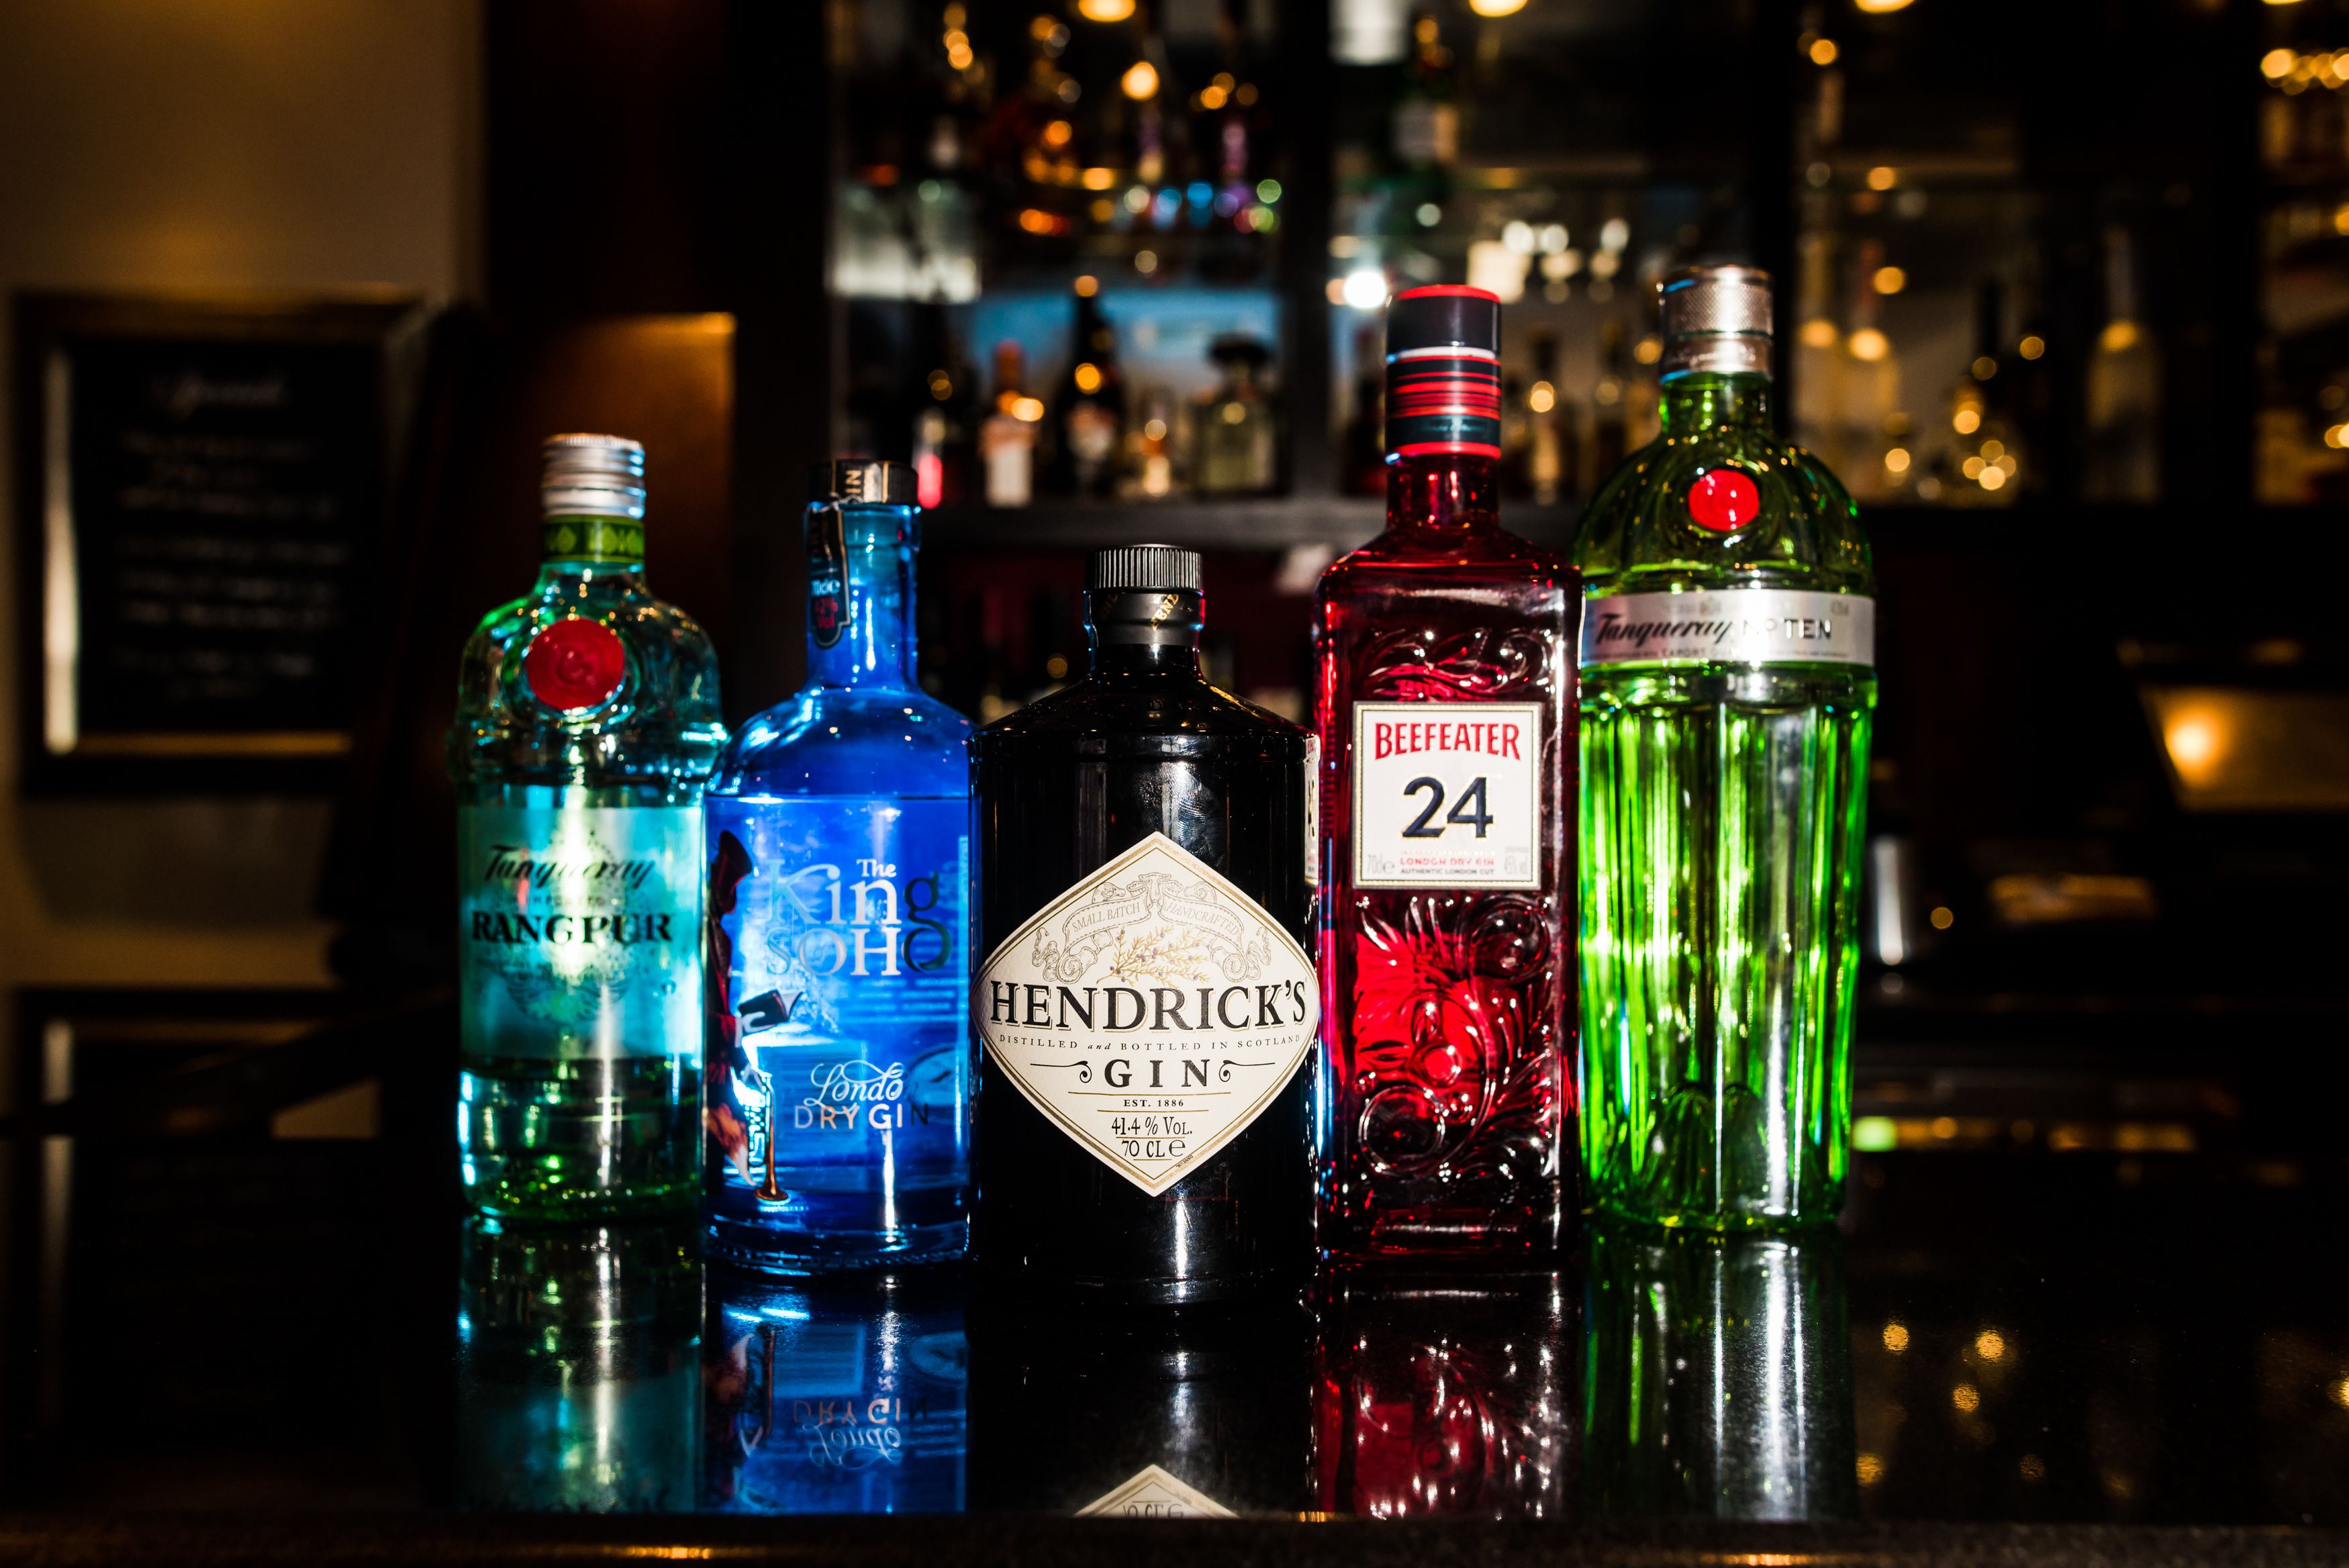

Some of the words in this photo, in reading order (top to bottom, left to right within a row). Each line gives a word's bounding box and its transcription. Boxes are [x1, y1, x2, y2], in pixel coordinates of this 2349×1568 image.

[1595, 613, 1733, 648] Tanqueray
[1780, 618, 1831, 640] TEN
[1375, 723, 1521, 761] BEEFEATER
[1402, 777, 1494, 838] 24
[857, 858, 898, 878] The
[767, 859, 948, 940] King
[473, 910, 671, 944] RANGPUR
[1072, 912, 1105, 932] SMALL
[1107, 901, 1140, 920] BATCH
[1165, 902, 1239, 935] HANDCRAFTED
[766, 926, 951, 976] SOHO
[990, 979, 1306, 1032] HENDRICK'S
[1000, 1034, 1077, 1048] DISTILLED
[1120, 1042, 1201, 1050] BOTTLED
[1211, 1041, 1229, 1049] IN
[1237, 1034, 1300, 1048] SCOTLAND
[1104, 1059, 1210, 1088] GIN
[794, 1106, 860, 1129] DRY
[868, 1103, 929, 1130] GIN
[1123, 1099, 1151, 1108] EST.
[1157, 1099, 1184, 1108] 1886
[1121, 1139, 1140, 1157] 70
